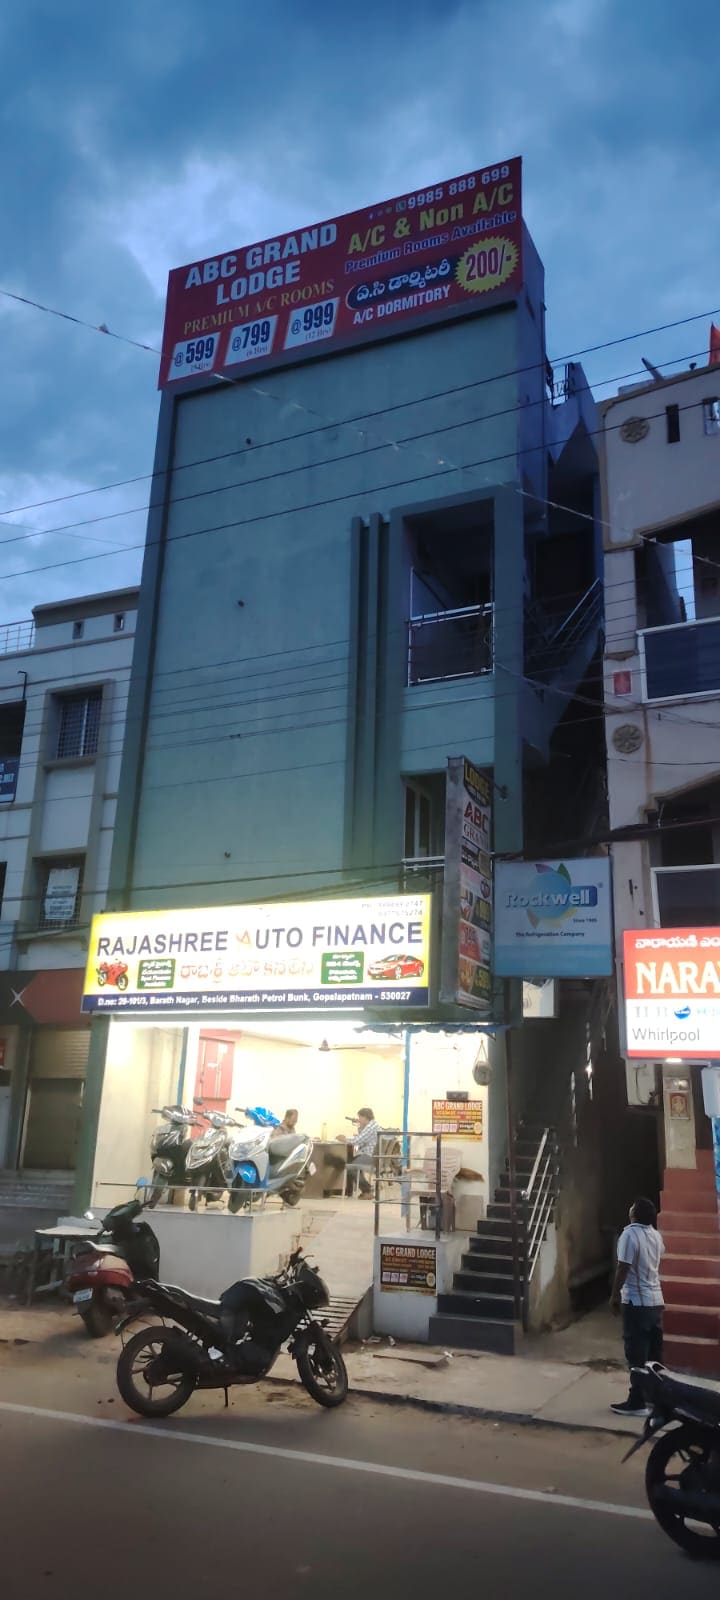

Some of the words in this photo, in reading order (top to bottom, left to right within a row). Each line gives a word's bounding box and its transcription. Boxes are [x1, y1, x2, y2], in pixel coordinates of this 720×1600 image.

[407, 187, 444, 209] 9985
[448, 176, 476, 195] 888
[481, 165, 510, 185] 699
[347, 224, 386, 254] A/C
[393, 217, 412, 239] &
[419, 203, 464, 231] Non
[472, 182, 514, 215] A/C
[185, 255, 237, 289] ABC
[245, 223, 337, 270] GRAND
[345, 247, 400, 274] Premium
[403, 232, 449, 256] Rooms
[451, 210, 517, 241] Available
[216, 260, 301, 305] LODGE
[183, 304, 250, 335] PREMIUM
[254, 294, 277, 315] A/C
[280, 279, 335, 307] ROOMS
[353, 307, 374, 325] A/C
[377, 284, 451, 317] DORMITORY
[464, 800, 489, 833] ABC
[97, 930, 229, 957] RAJASHREE
[312, 921, 423, 947] FINANCE
[261, 992, 286, 1003] Petrol
[632, 1027, 700, 1045] Whirlpool
[382, 1246, 395, 1256] ABC
[395, 1247, 416, 1258] GRAND
[416, 1248, 436, 1260] LODGE
